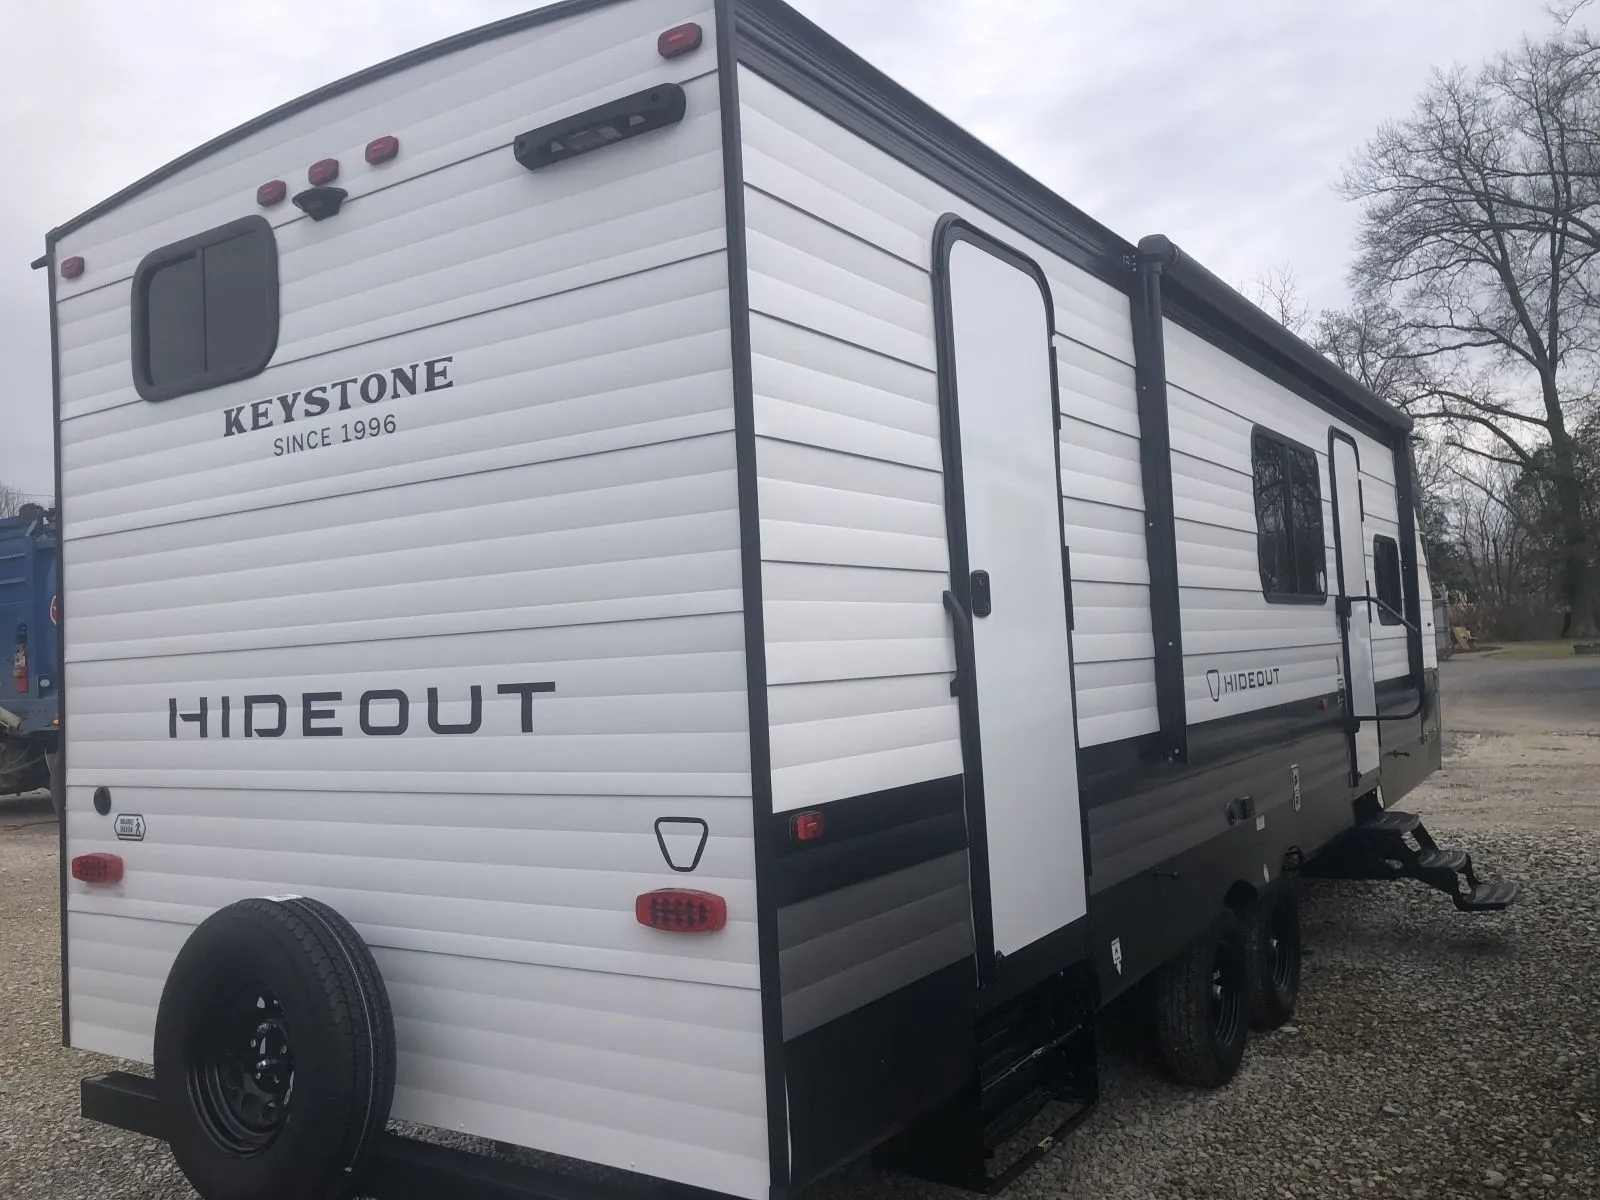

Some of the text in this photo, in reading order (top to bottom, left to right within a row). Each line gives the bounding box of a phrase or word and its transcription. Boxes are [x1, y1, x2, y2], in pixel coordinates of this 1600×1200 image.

[223, 356, 454, 437] KEYSTONE
[273, 413, 396, 456] SINCE 1996
[1223, 668, 1280, 693] HIDEOUT
[168, 681, 556, 738] HIDEOUT
